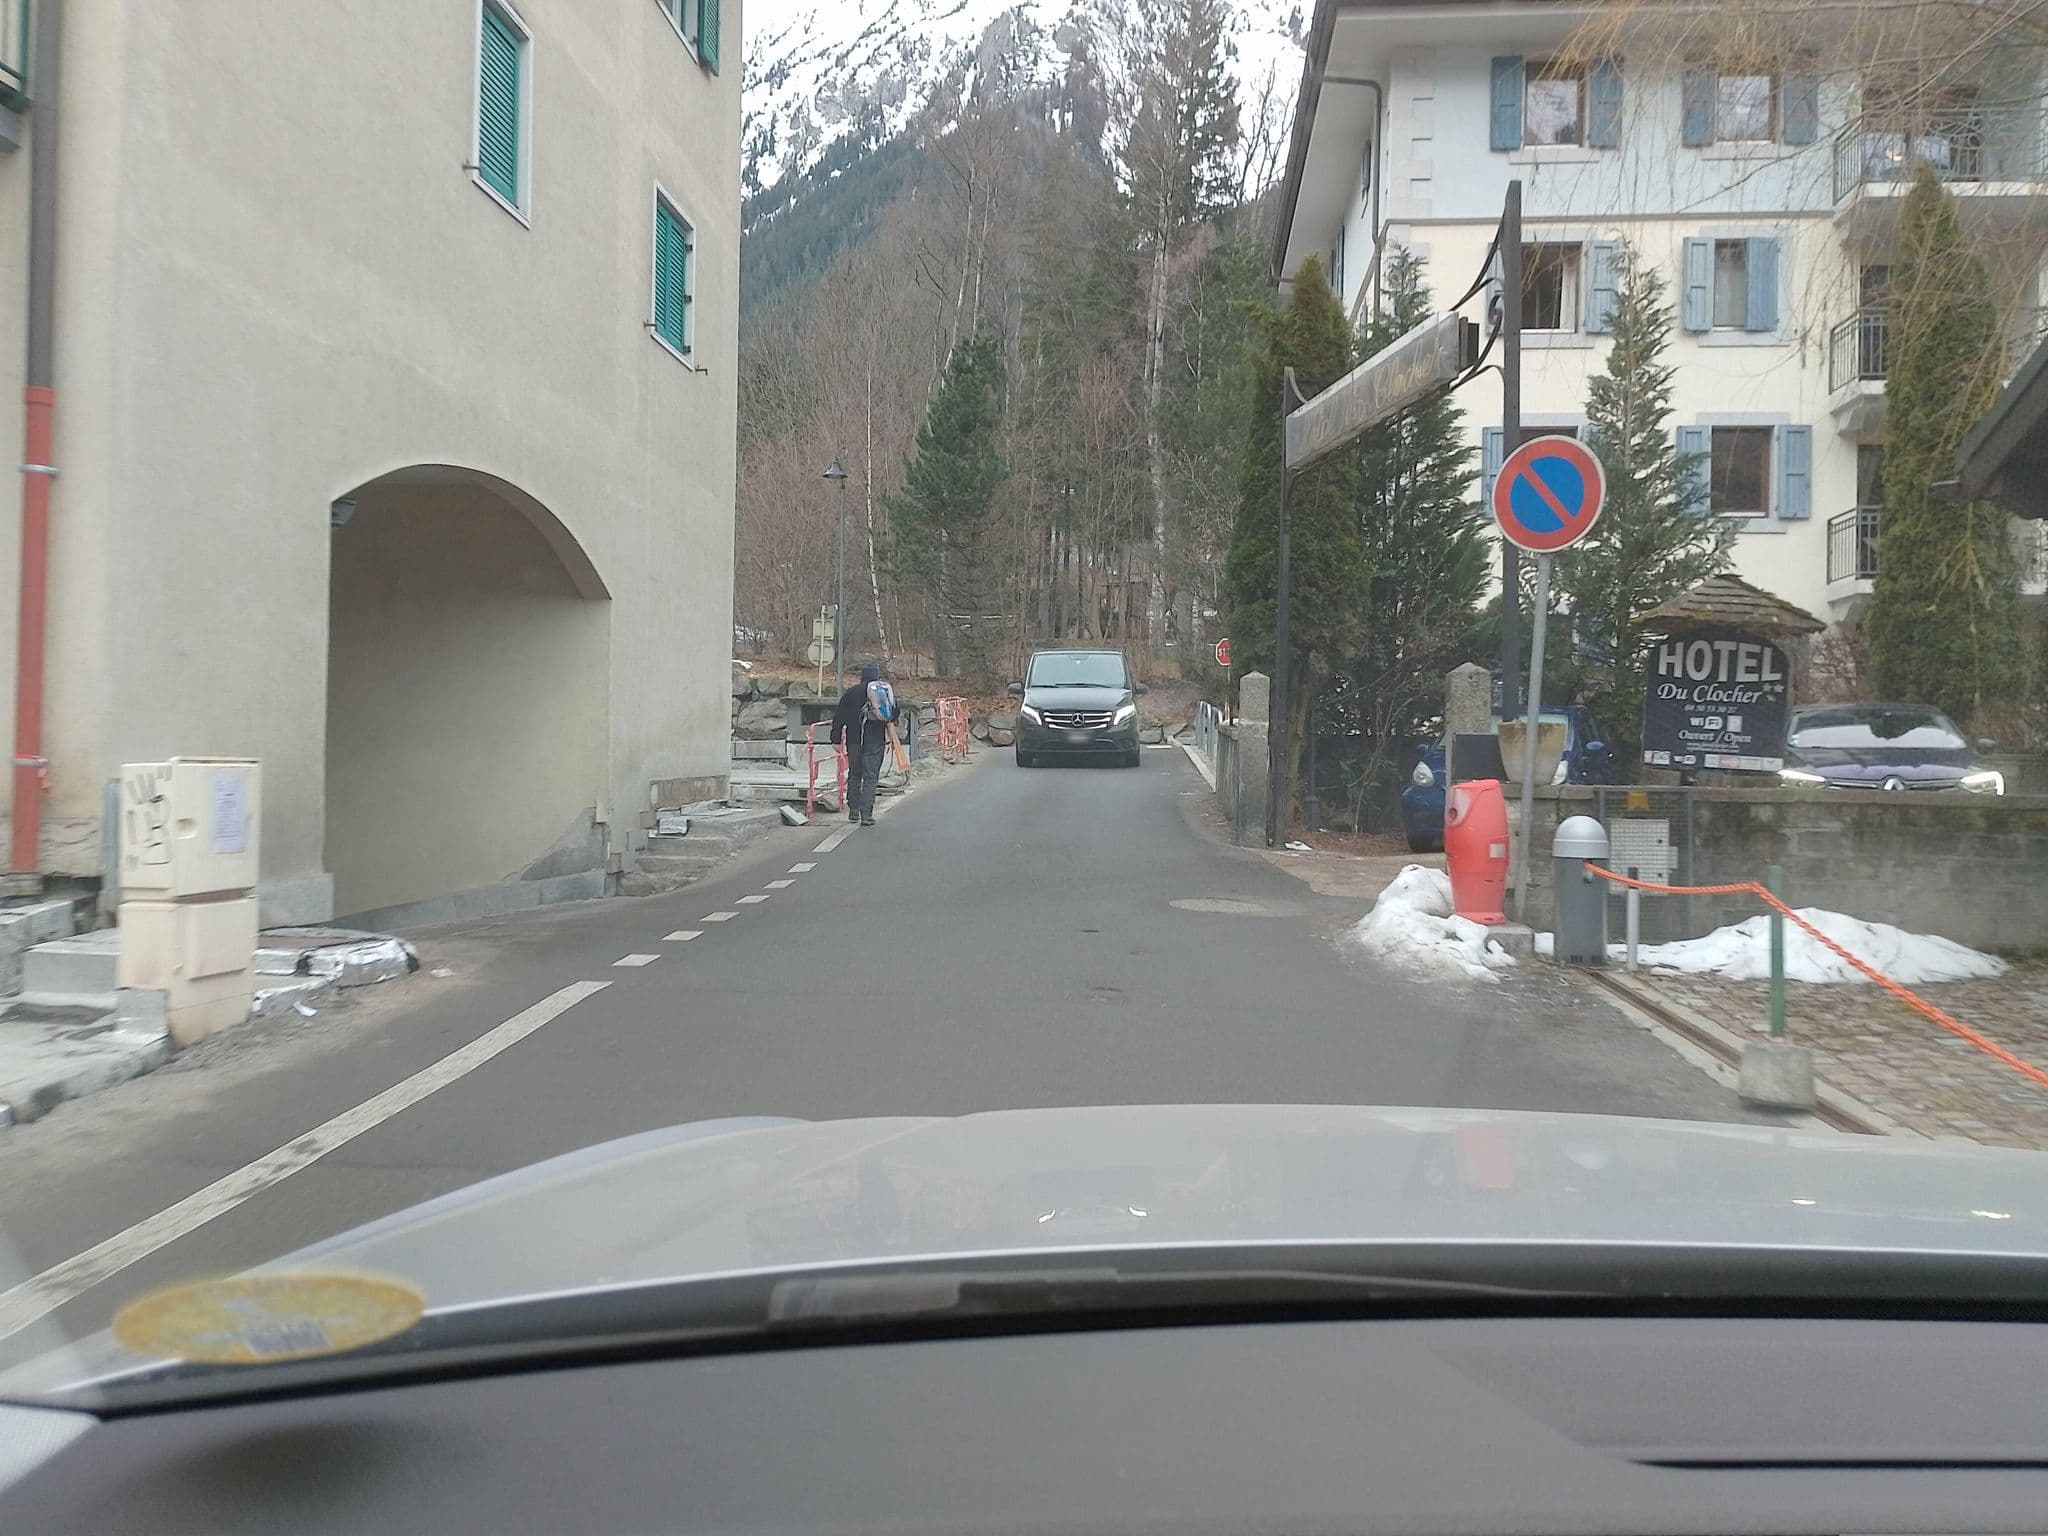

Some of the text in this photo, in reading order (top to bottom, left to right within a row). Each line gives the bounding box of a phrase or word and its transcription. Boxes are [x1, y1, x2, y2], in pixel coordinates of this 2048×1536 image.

[1658, 640, 1782, 682] HOTEL
[1657, 683, 1763, 703] Du Clocher
[1678, 729, 1714, 741] Ouvert
[1724, 732, 1752, 745] Open
